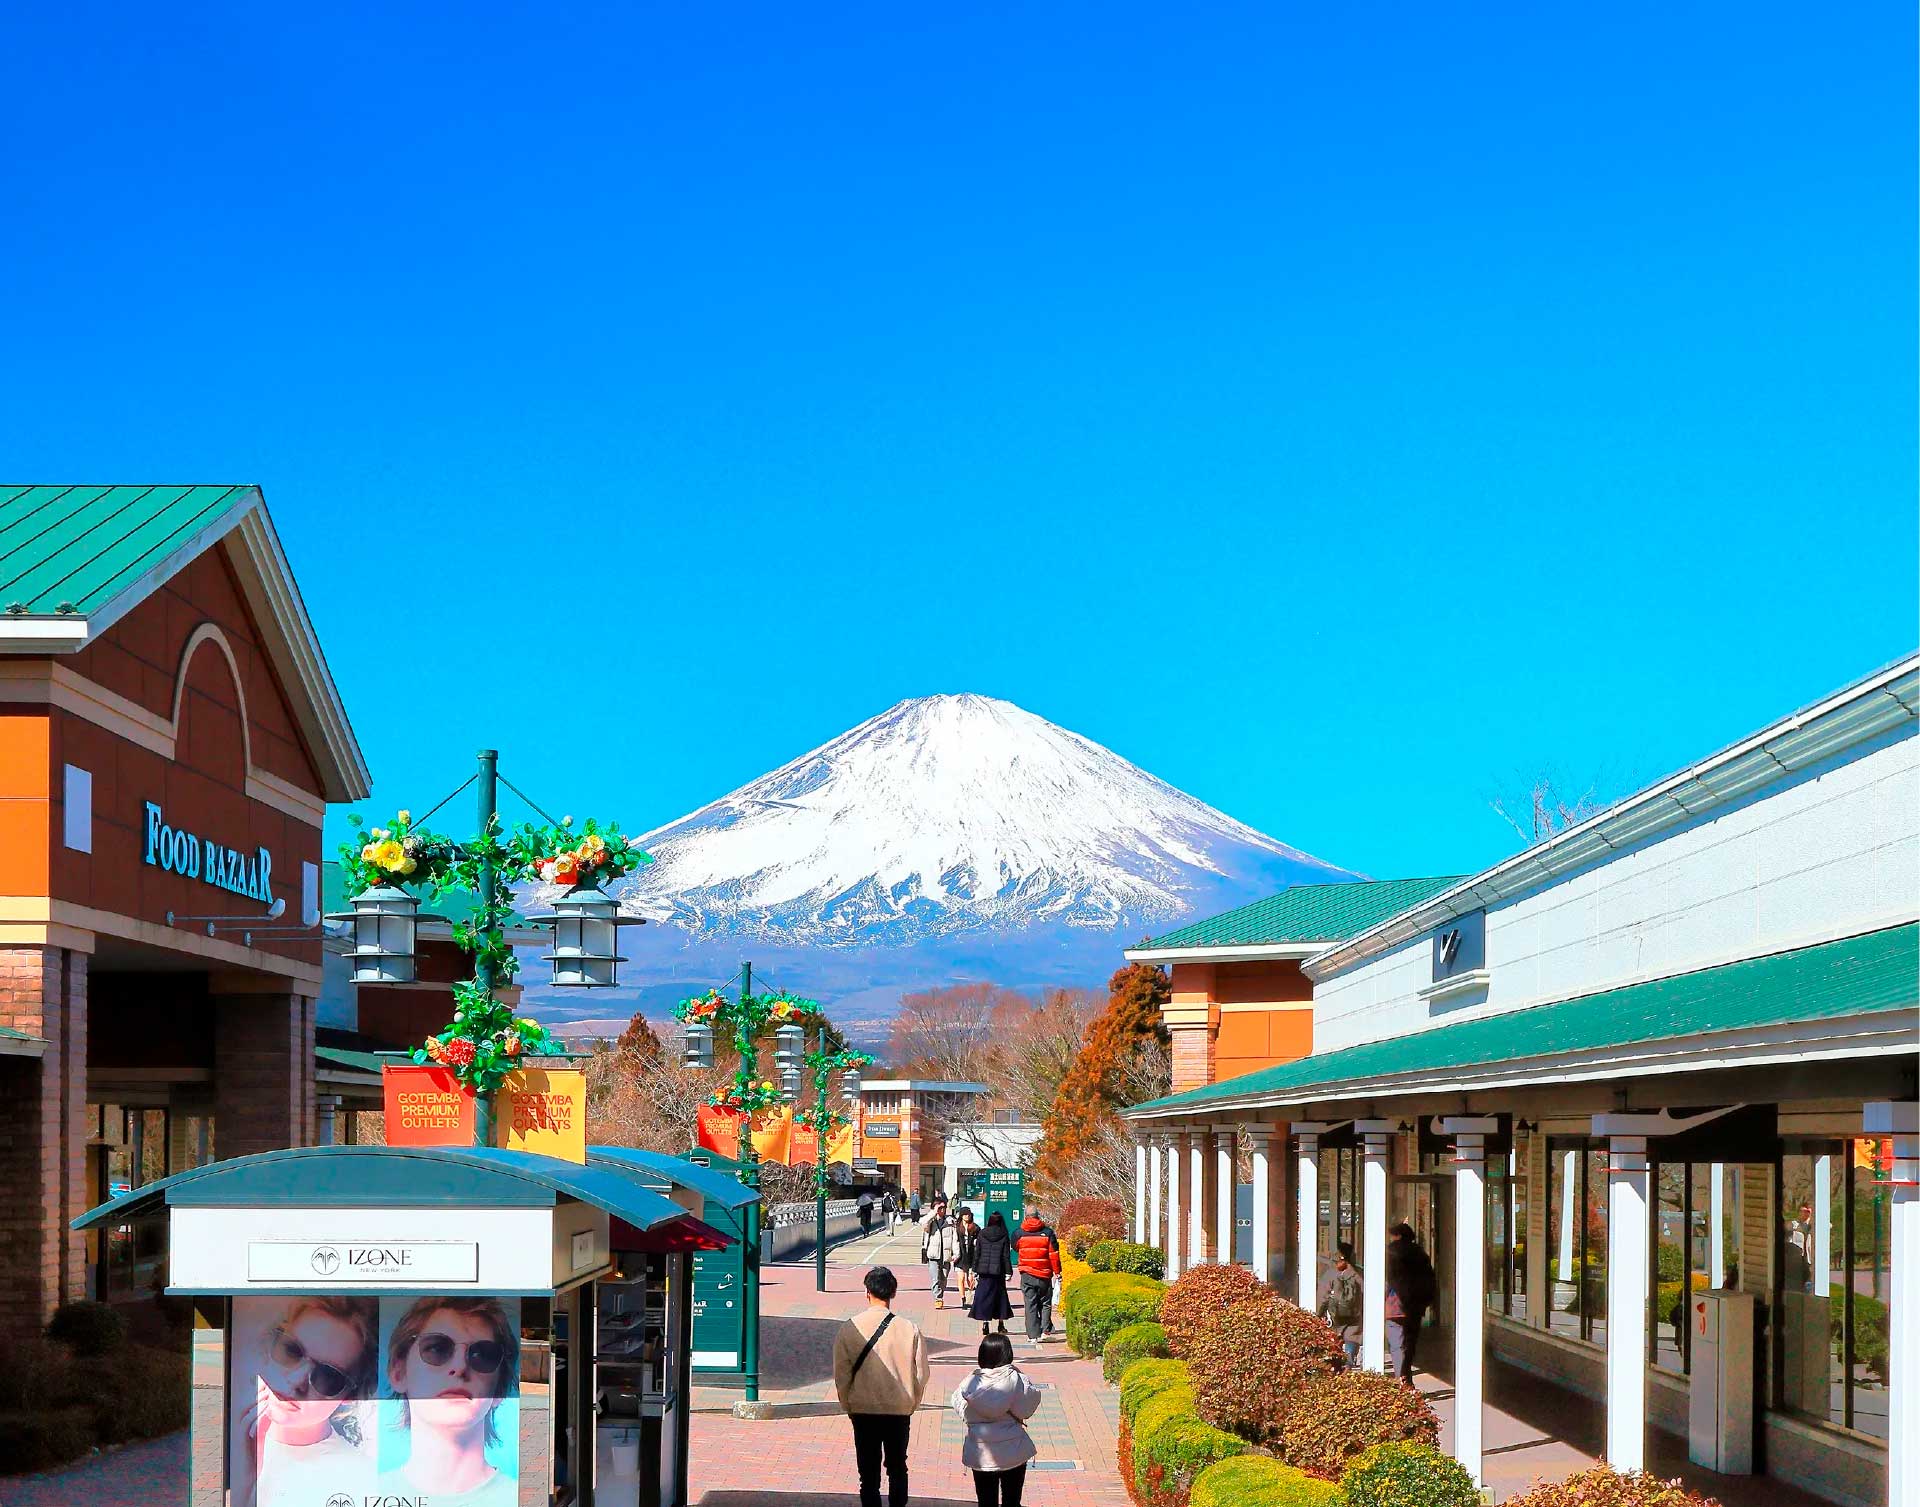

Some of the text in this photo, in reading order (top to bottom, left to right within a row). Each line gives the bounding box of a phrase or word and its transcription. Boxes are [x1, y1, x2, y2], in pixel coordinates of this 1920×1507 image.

[145, 800, 274, 905] FOOD BAZAAR
[397, 1092, 463, 1104] GOTEMBA
[510, 1093, 574, 1106] GOTEMBA
[401, 1104, 460, 1116] PREMIUM
[513, 1106, 571, 1118] PREMIUM
[401, 1117, 460, 1129] OUTLETS
[513, 1118, 572, 1130] OUTLETS
[349, 1248, 412, 1266] IZONE
